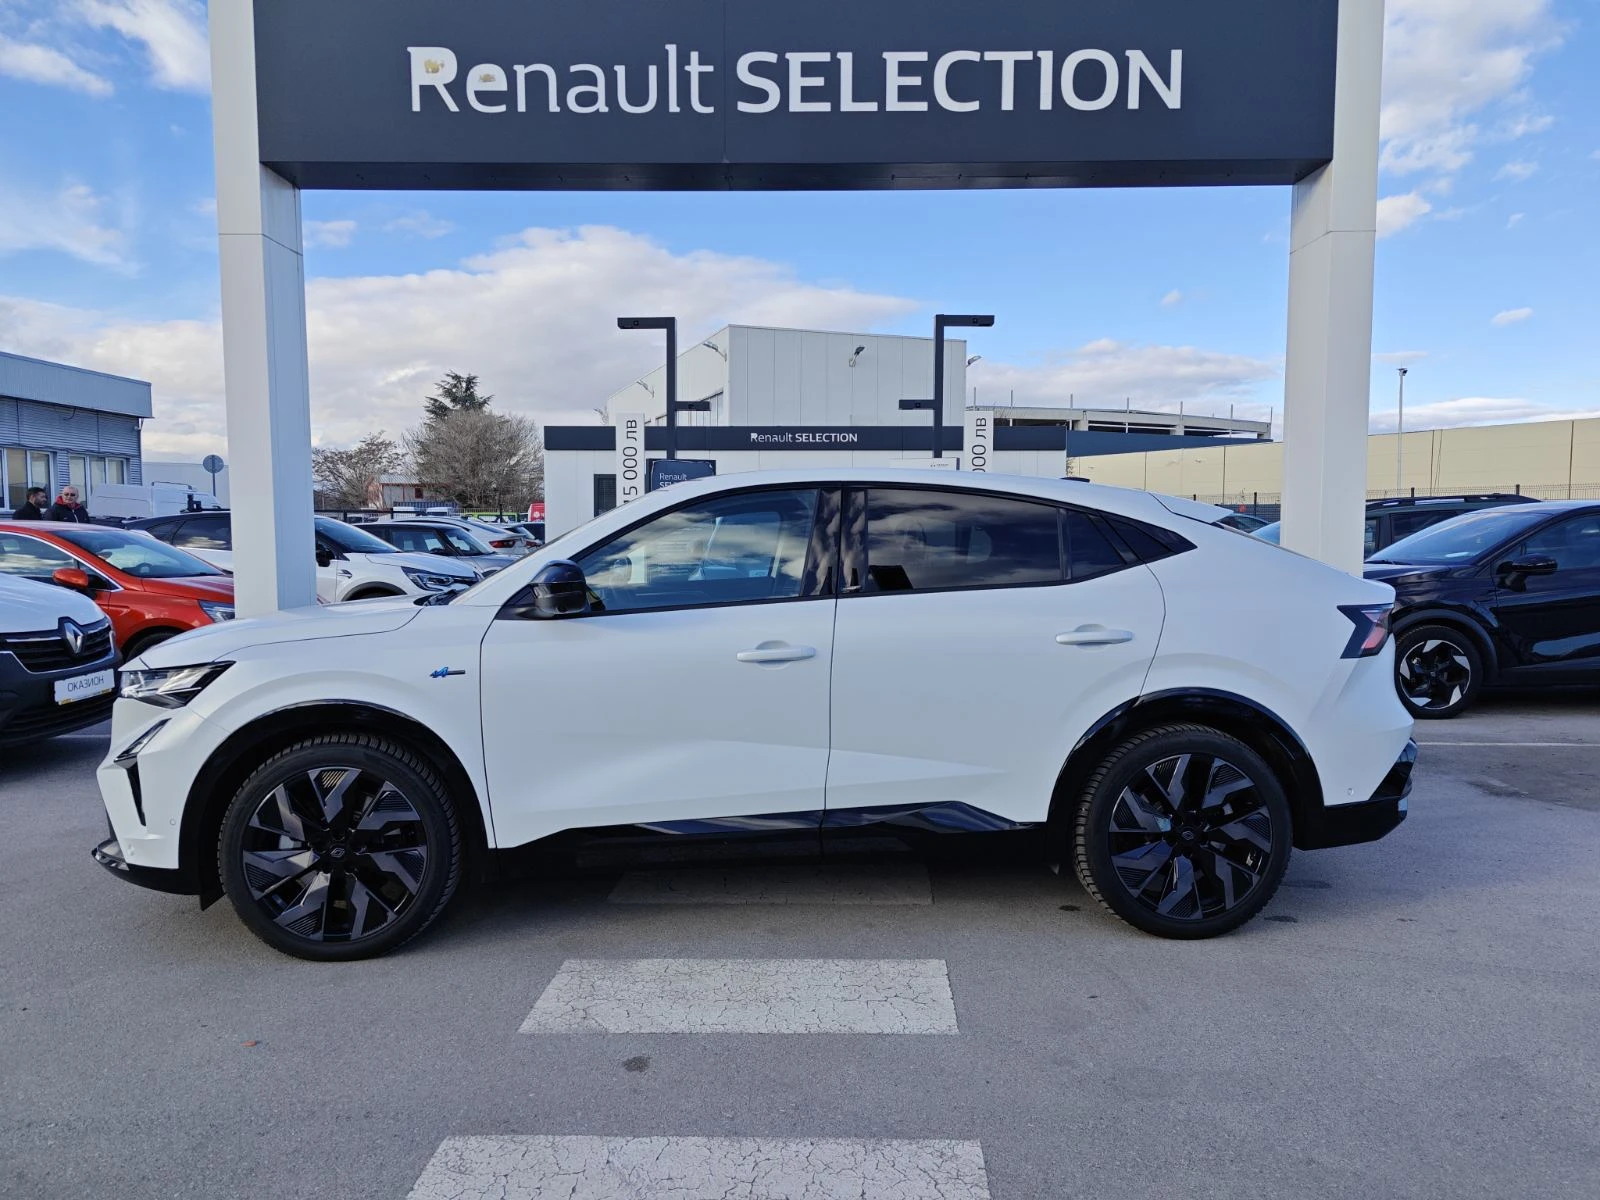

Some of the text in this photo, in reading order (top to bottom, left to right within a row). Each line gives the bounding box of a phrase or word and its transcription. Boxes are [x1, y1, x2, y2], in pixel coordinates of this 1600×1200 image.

[407, 44, 1183, 114] Renault SELECTION
[750, 432, 858, 443] Renault SELECTION
[622, 446, 638, 481] 000
[659, 472, 687, 481] Renault
[67, 675, 104, 692] ОКАЗИОН
